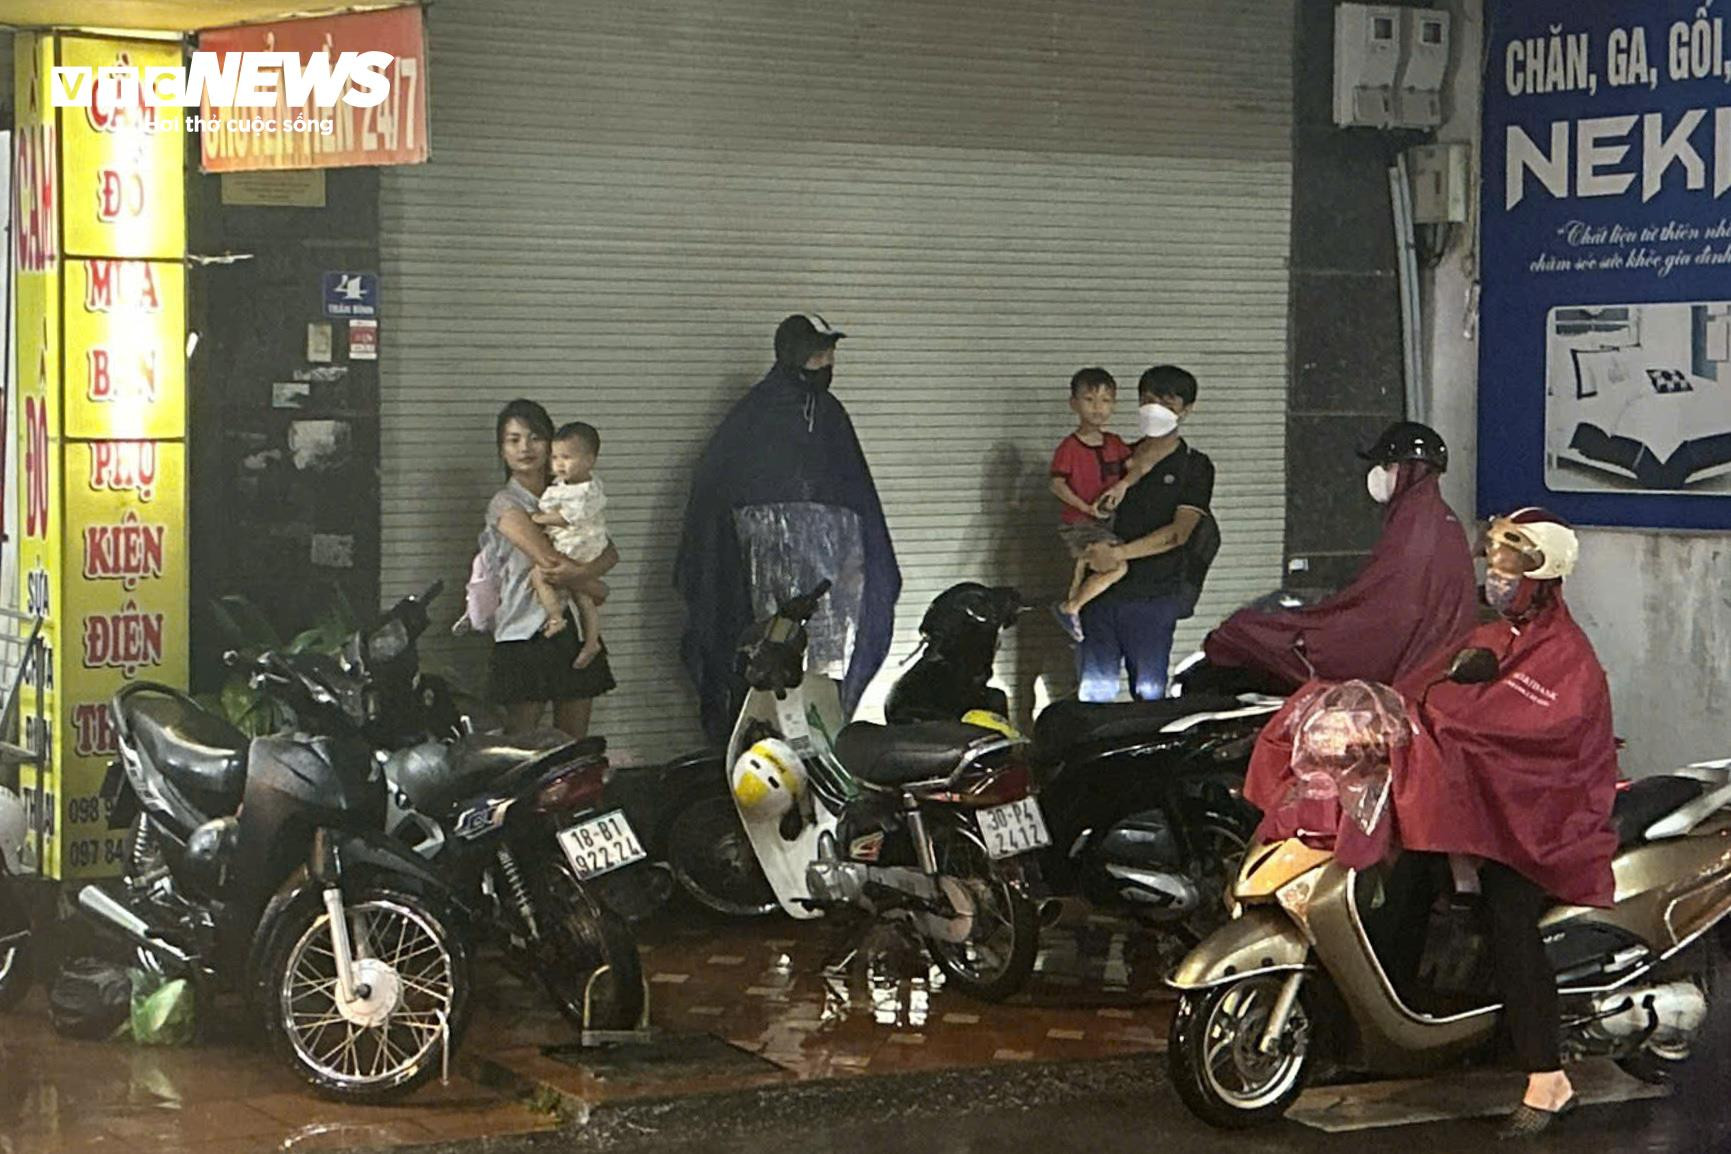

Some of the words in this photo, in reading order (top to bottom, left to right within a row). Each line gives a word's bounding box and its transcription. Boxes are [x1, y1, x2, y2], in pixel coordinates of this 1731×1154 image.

[1506, 23, 1597, 96] CHĂN,
[1608, 26, 1658, 90] GA,
[333, 274, 369, 300] 4
[86, 512, 164, 588] KIỆN
[86, 600, 164, 675] ĐIỆN
[69, 796, 99, 824] 098
[987, 800, 1033, 838] 30-P4
[570, 818, 622, 850] 18-B1
[995, 823, 1042, 854] 2412
[70, 840, 98, 867] 097
